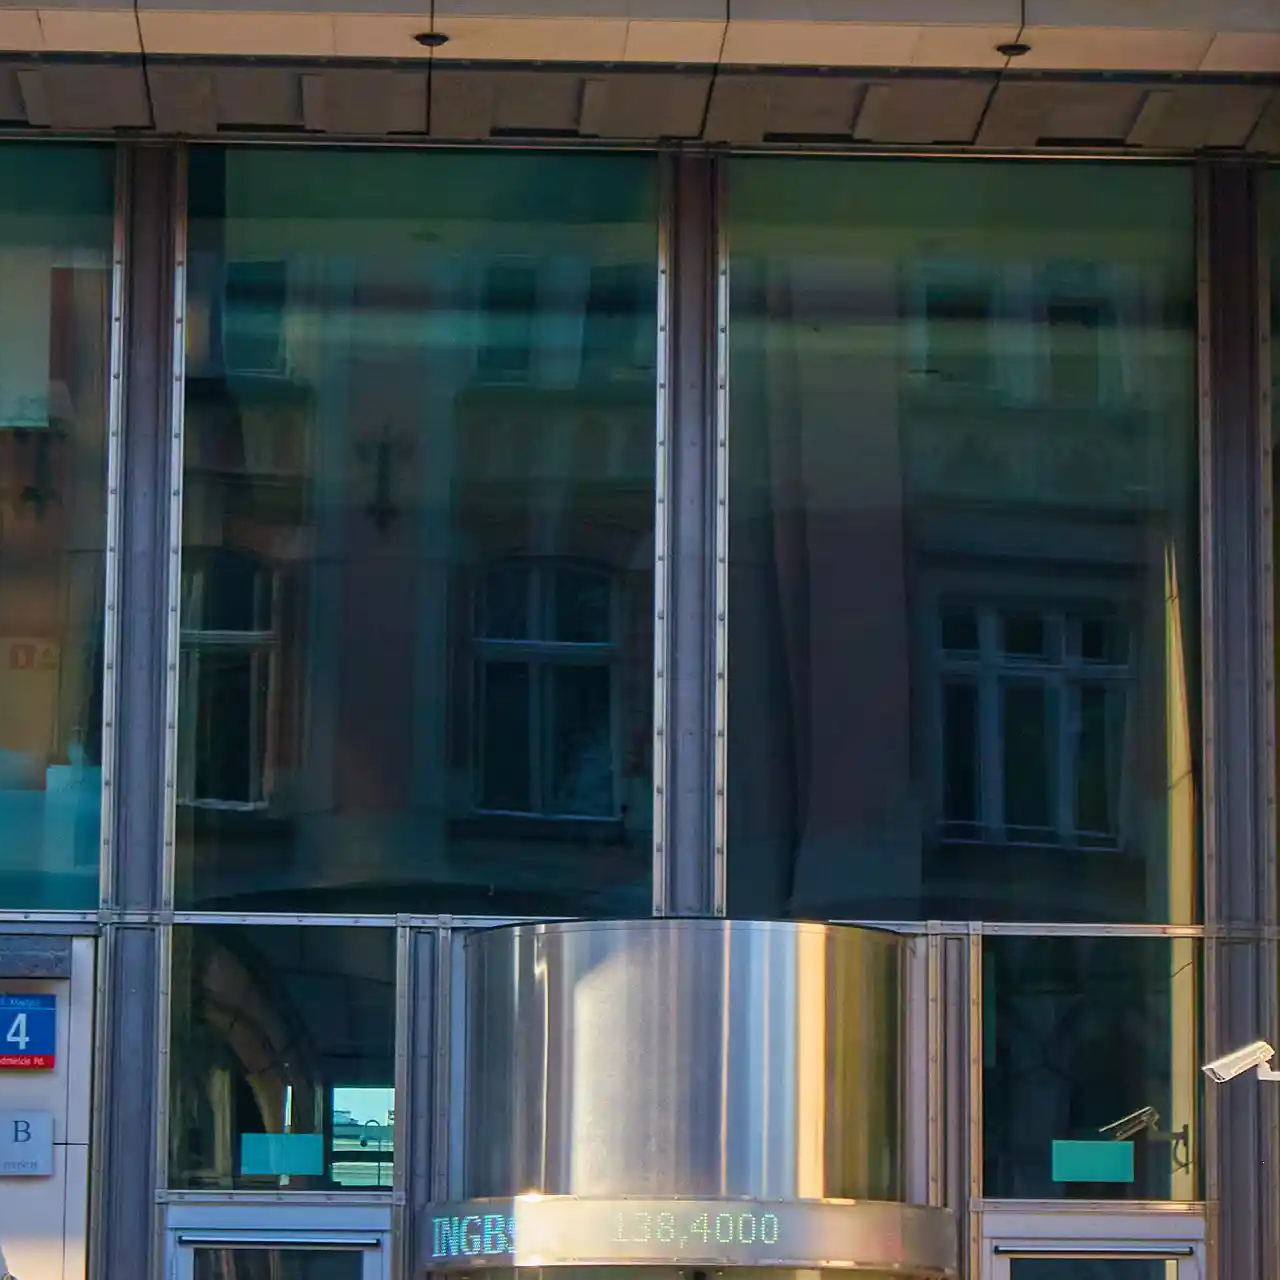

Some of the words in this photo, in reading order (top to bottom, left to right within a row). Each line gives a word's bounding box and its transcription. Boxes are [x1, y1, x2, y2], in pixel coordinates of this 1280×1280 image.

[7, 1013, 30, 1050] 4
[12, 1120, 32, 1142] B
[612, 1212, 779, 1249] 138,4000
